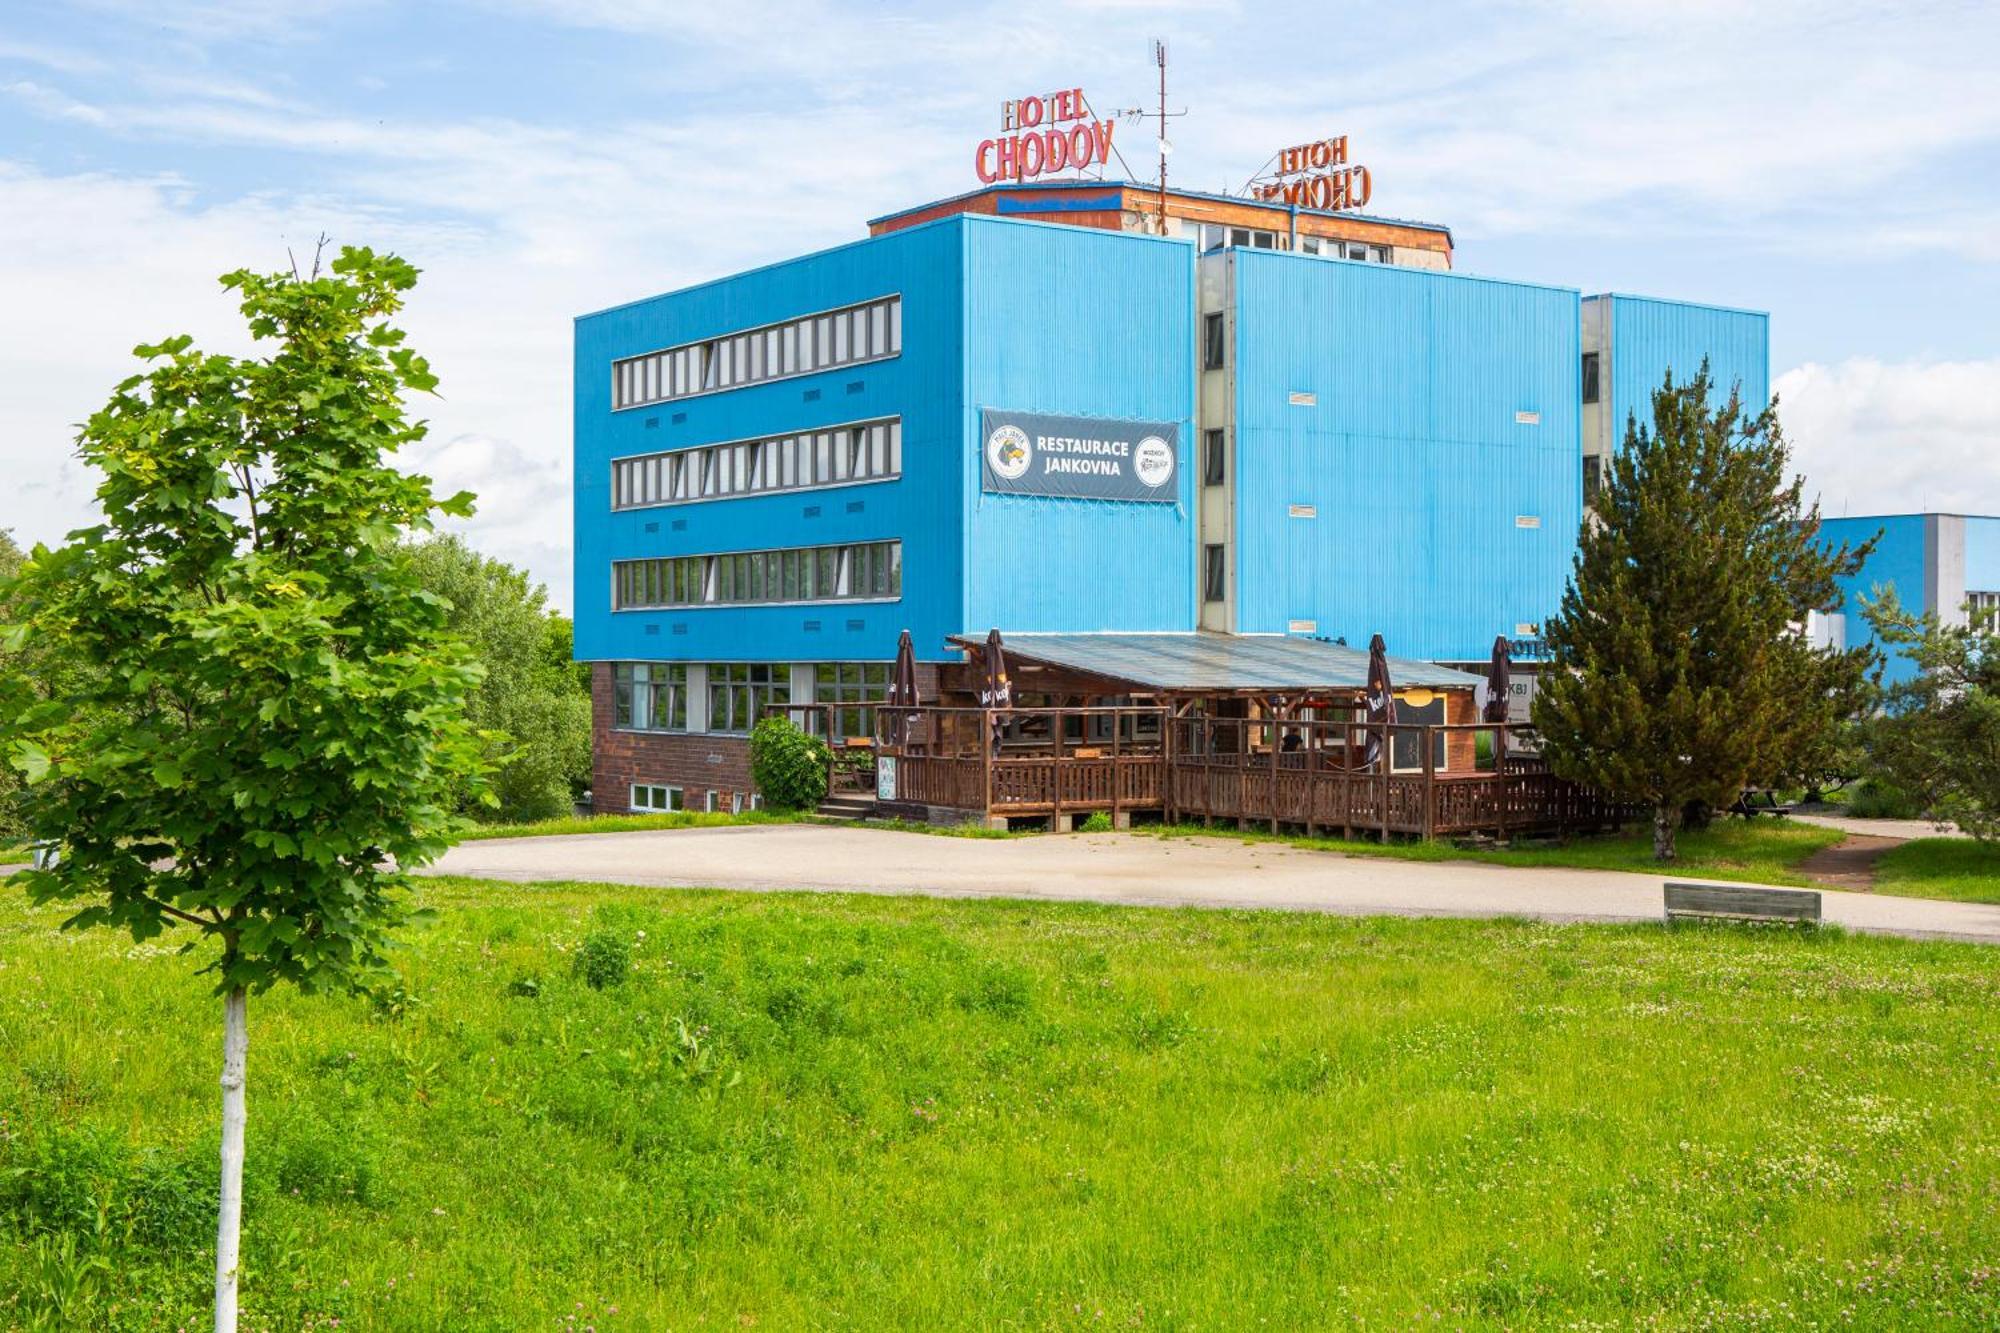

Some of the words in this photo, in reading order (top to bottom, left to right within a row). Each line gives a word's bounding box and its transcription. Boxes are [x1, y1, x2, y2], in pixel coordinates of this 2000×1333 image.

[1000, 88, 1088, 132] HOTEL
[976, 119, 1114, 184] CHODOV
[1037, 436, 1129, 456] RESTAURACE
[1045, 457, 1121, 476] JANKOVNA
